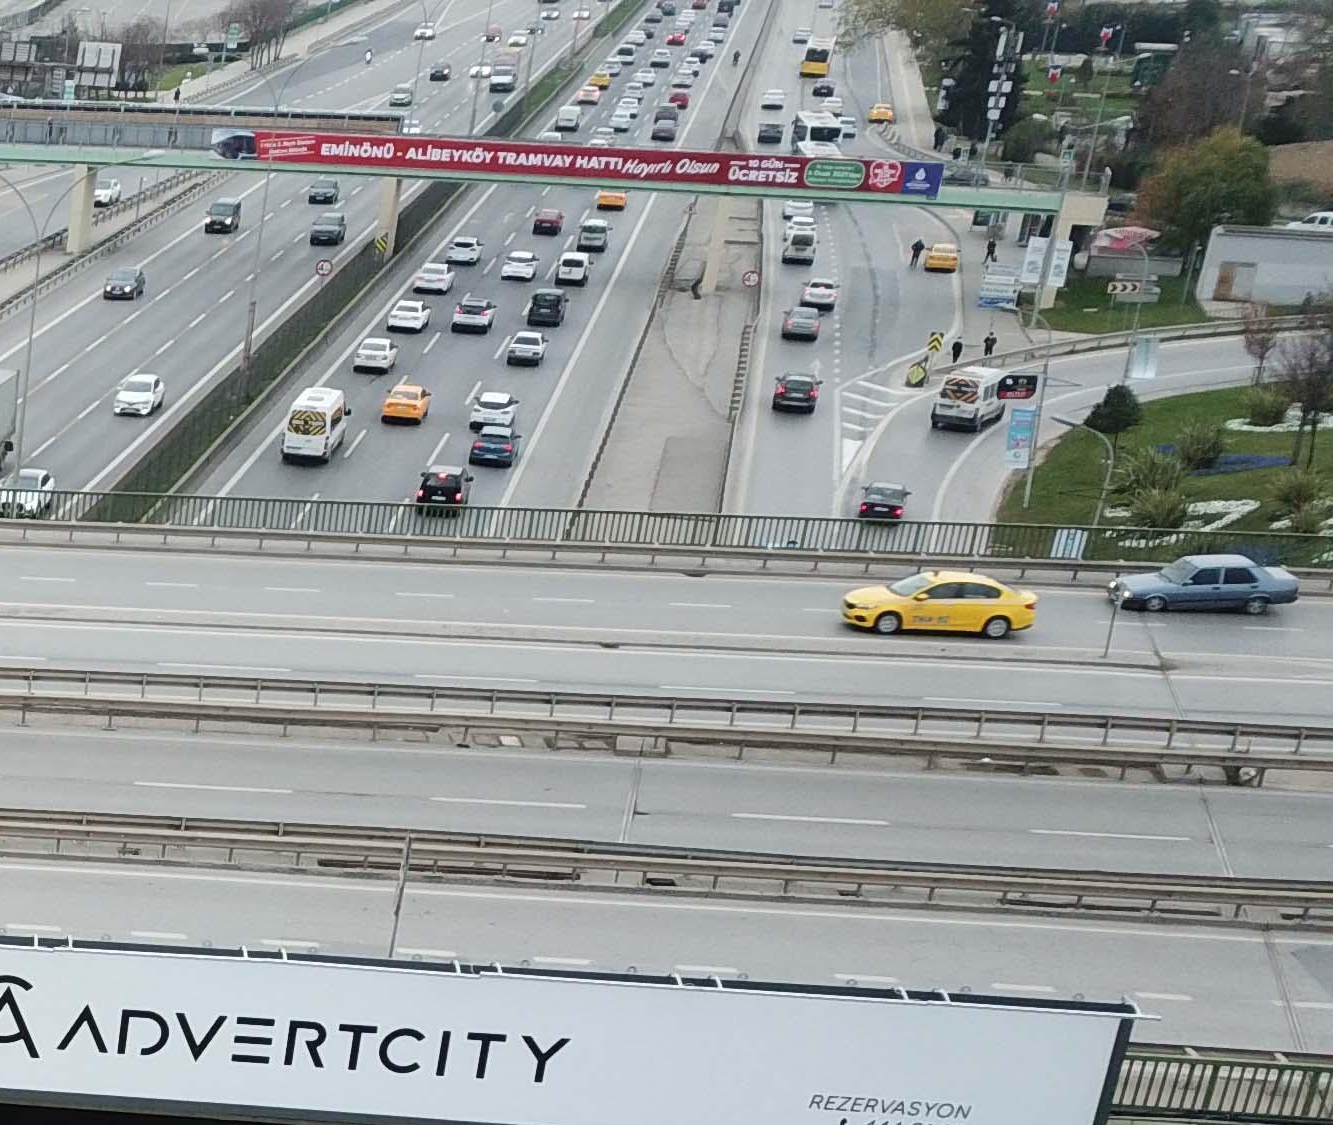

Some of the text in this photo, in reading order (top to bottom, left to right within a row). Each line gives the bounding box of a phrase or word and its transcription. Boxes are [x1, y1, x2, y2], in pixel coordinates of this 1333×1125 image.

[320, 141, 395, 158] EMİNÖNÜ
[405, 144, 494, 164] ALİBEYKÖY
[497, 151, 574, 168] TRAMVAY
[575, 155, 623, 170] HATTI
[621, 158, 673, 178] Hayırlı
[675, 158, 720, 174] Olsun
[728, 165, 799, 183] ÜCRETSİZ
[56, 1004, 571, 1083] ADVERTCITY
[808, 1094, 973, 1120] REZERVASYON
